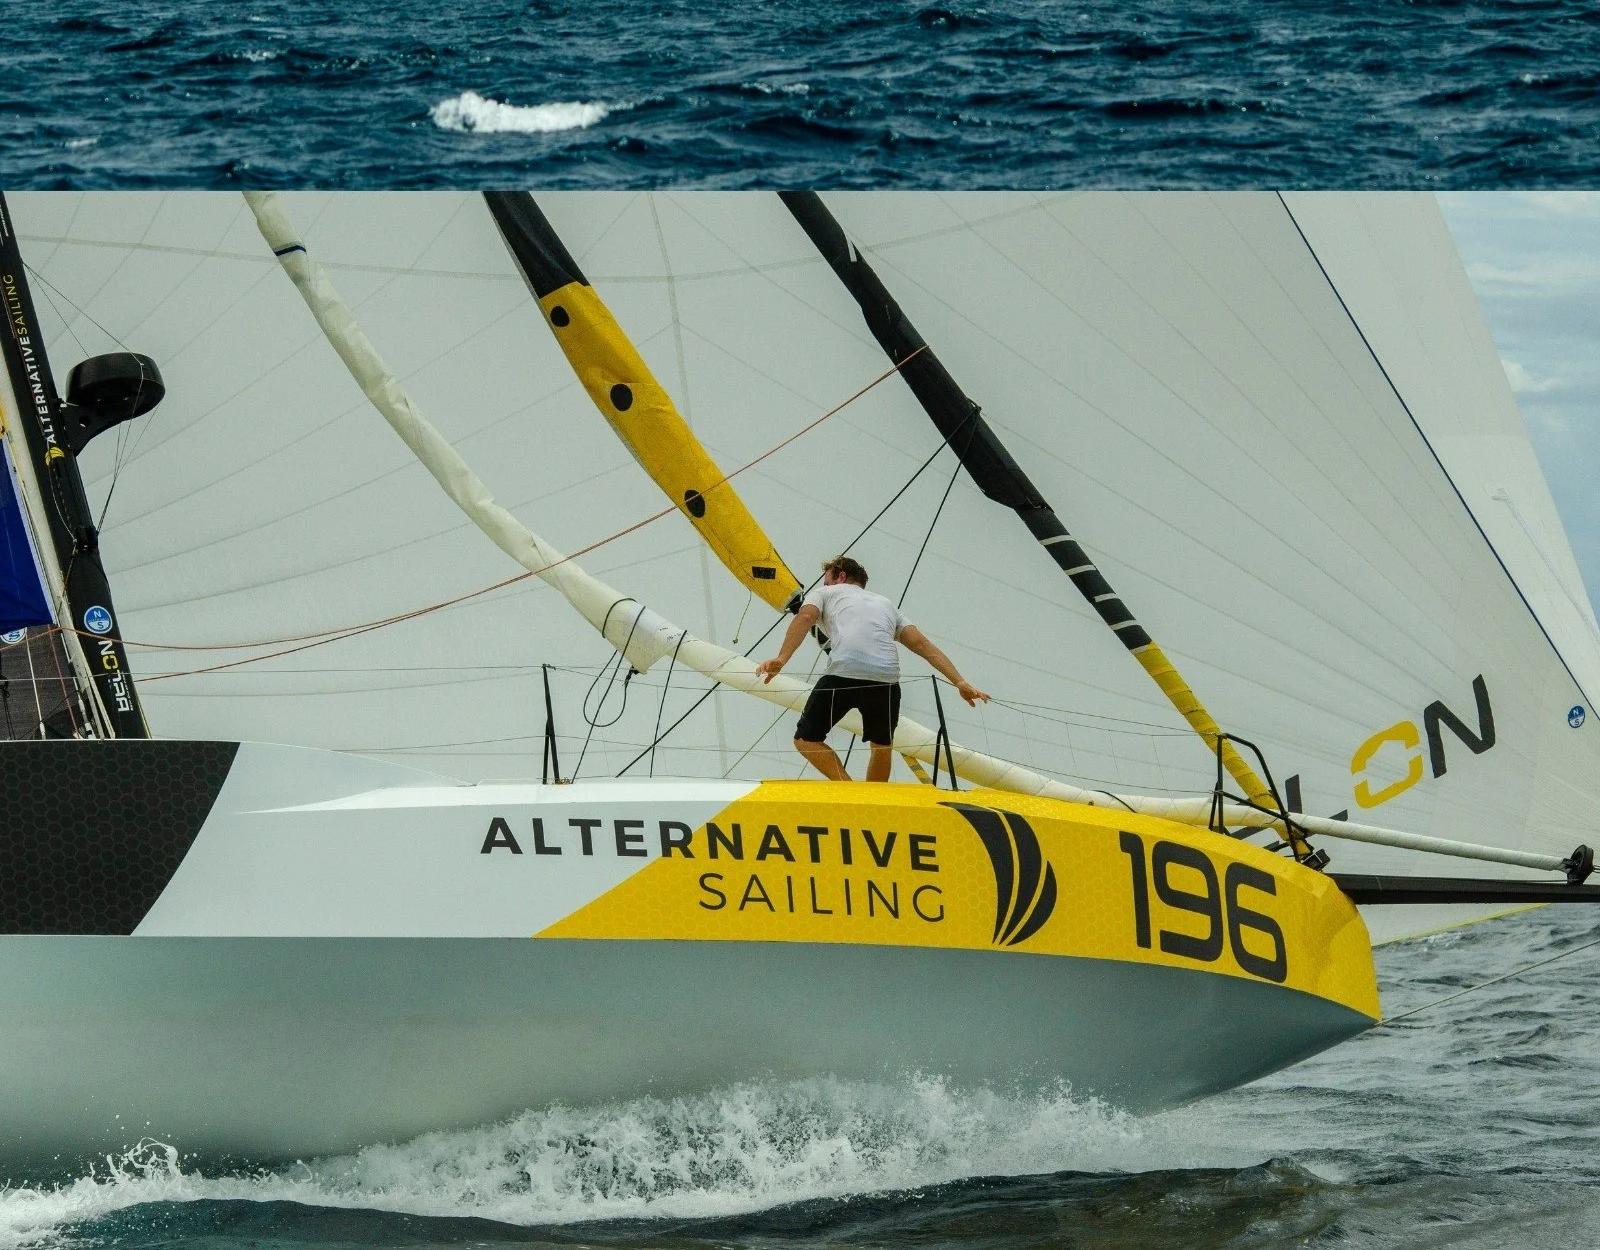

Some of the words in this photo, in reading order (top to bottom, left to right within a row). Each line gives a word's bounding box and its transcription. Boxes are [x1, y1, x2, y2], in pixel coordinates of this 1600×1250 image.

[480, 817, 941, 872] ALTERNATIVE
[698, 872, 946, 923] SAILING
[1119, 831, 1287, 984] 196
